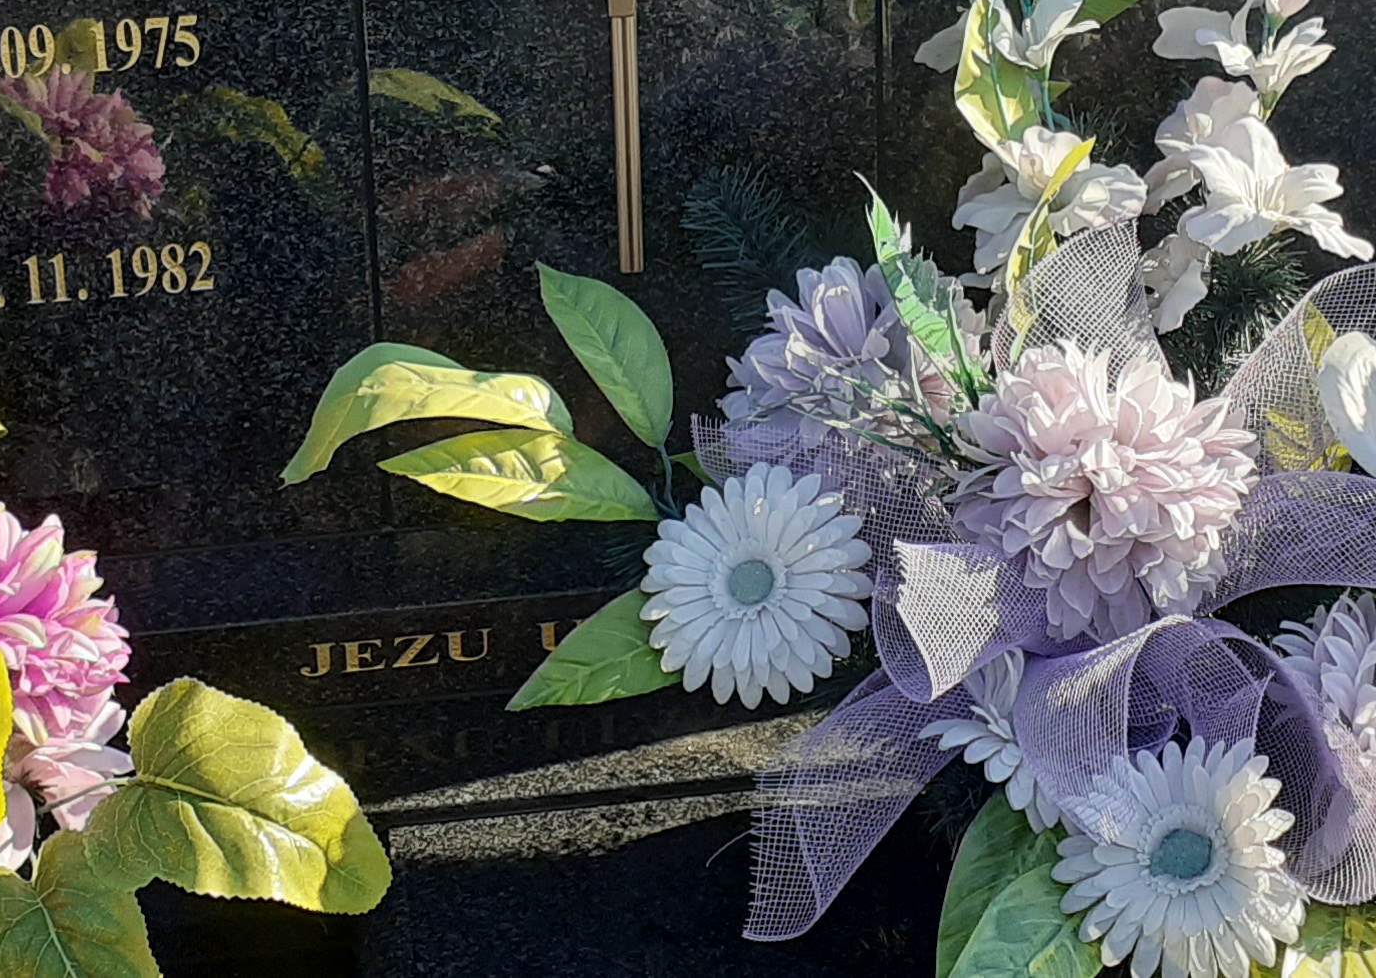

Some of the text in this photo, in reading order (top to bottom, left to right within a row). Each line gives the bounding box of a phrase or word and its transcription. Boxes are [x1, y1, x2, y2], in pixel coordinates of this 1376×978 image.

[0, 23, 72, 80] 09.
[89, 14, 201, 74] 1975
[22, 251, 89, 306] 11.
[106, 240, 216, 299] 1982
[298, 627, 490, 679] JEZU
